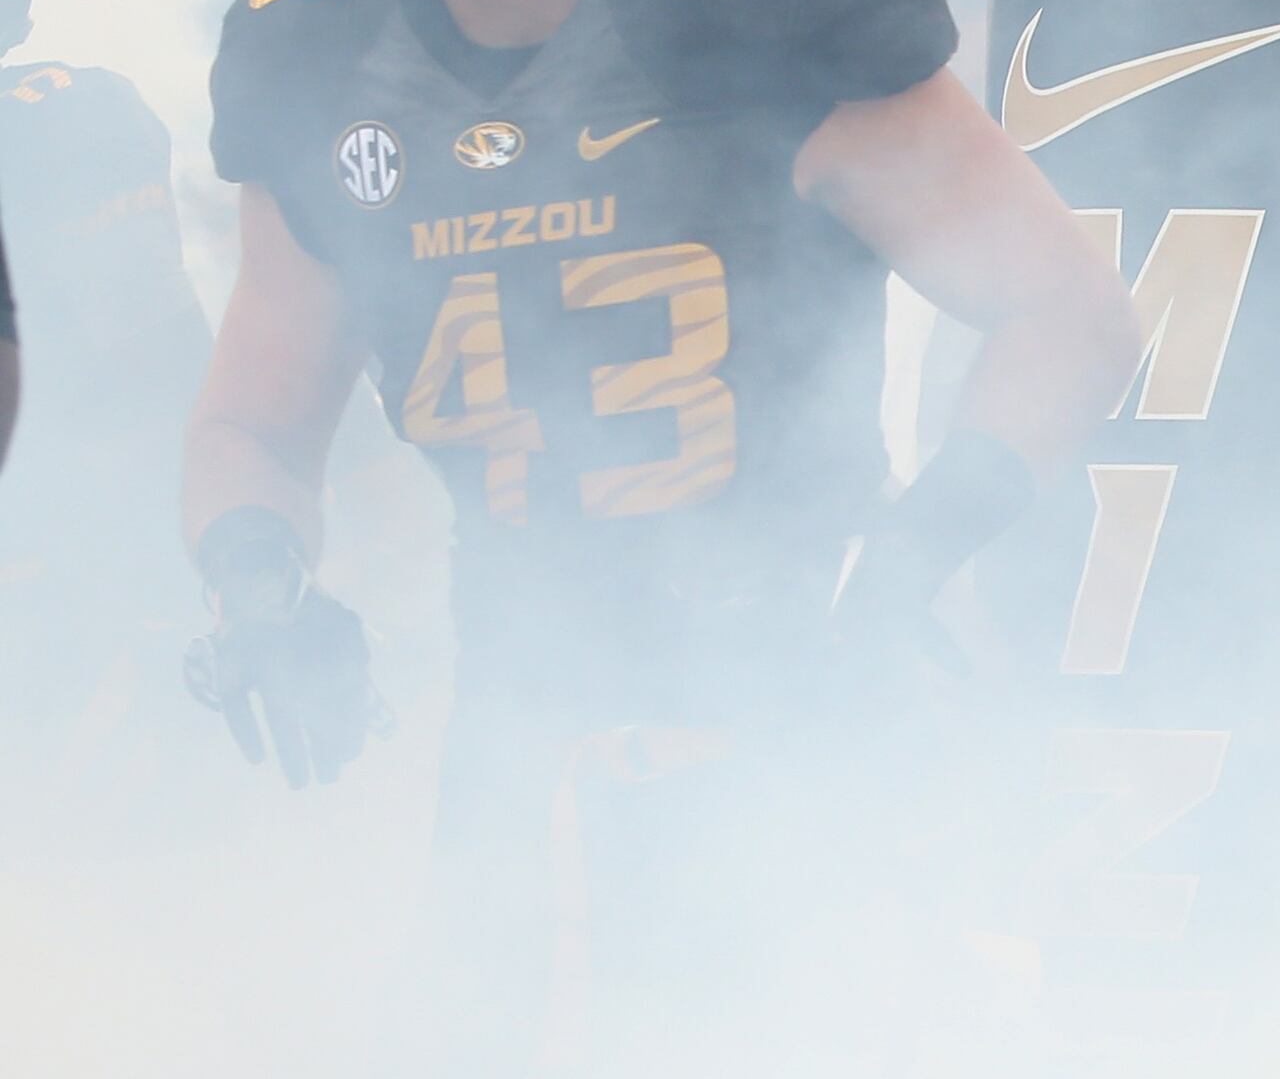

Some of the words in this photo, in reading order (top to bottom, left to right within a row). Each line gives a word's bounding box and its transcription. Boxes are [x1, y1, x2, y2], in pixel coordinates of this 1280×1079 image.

[340, 125, 399, 205] SEC
[411, 195, 617, 261] MIZZOU
[403, 242, 737, 527] 43
